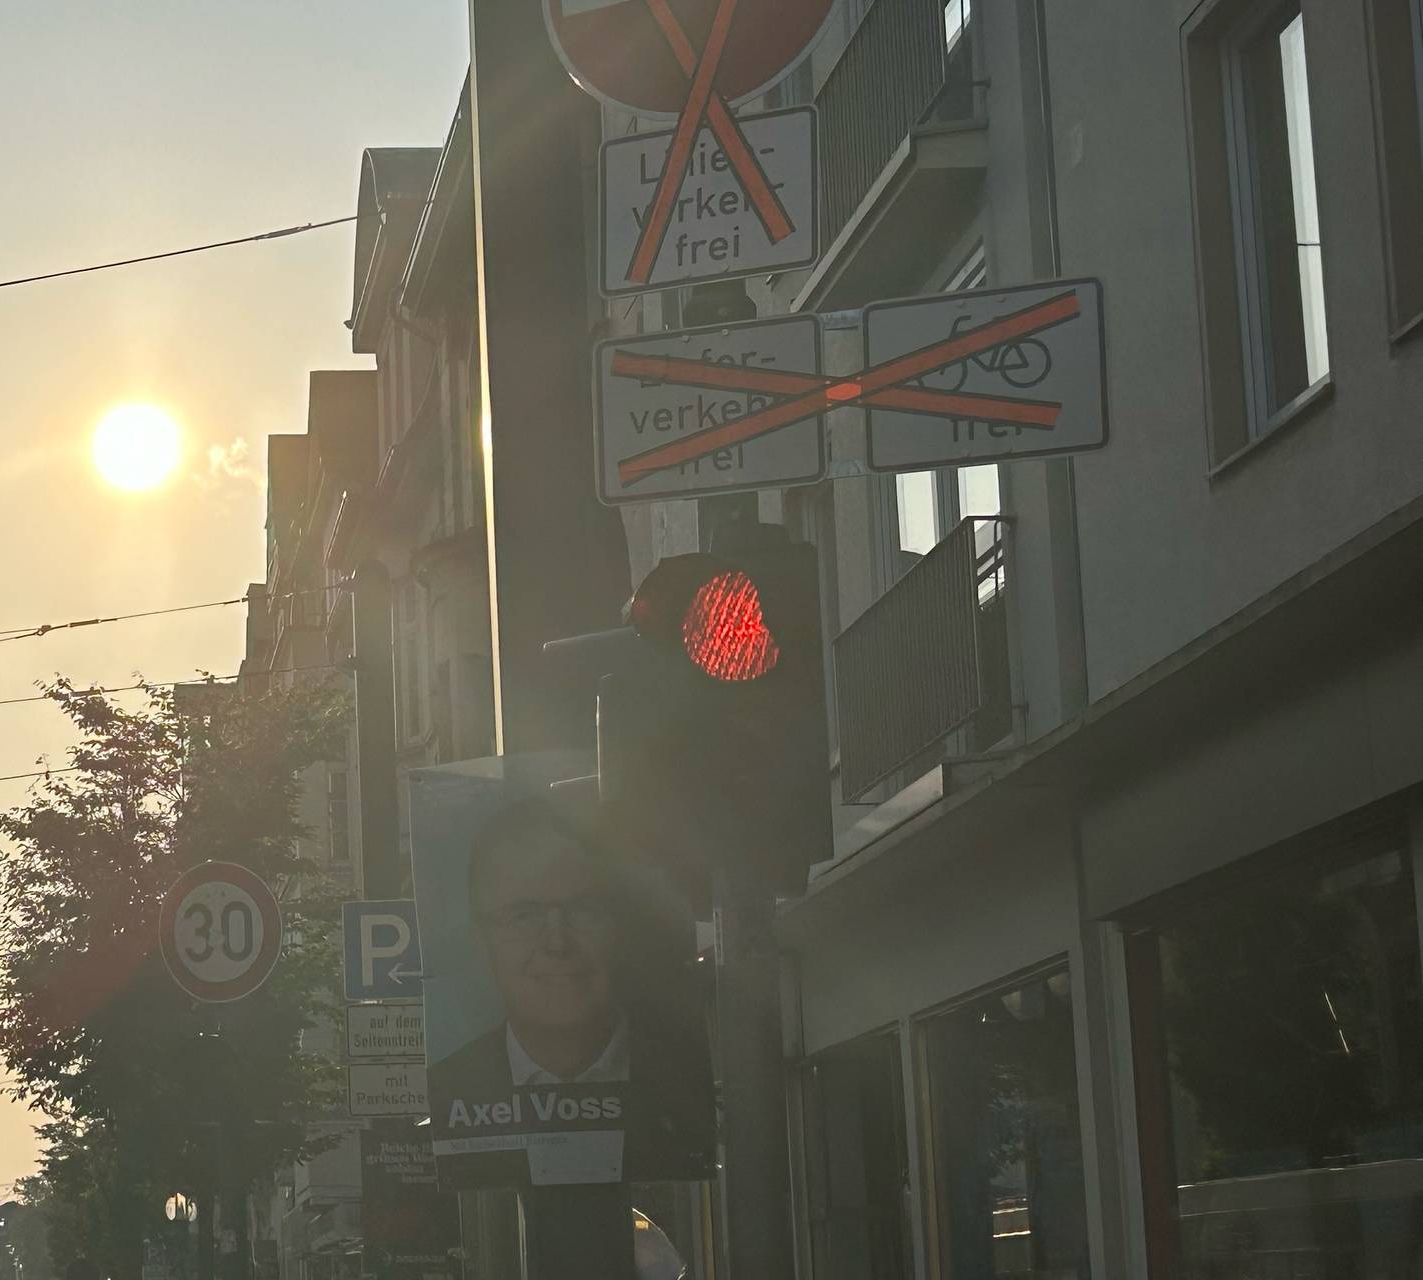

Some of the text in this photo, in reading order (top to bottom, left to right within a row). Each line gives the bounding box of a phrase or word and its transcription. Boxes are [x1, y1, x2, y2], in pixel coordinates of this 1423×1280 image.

[641, 143, 774, 184] Lie-
[676, 226, 739, 266] frei
[630, 392, 776, 434] verkeh
[184, 901, 254, 962] 30
[360, 914, 411, 987] P
[370, 1014, 422, 1029] auf dem
[385, 1074, 408, 1088] mit
[448, 1091, 623, 1129] Axel Voss
